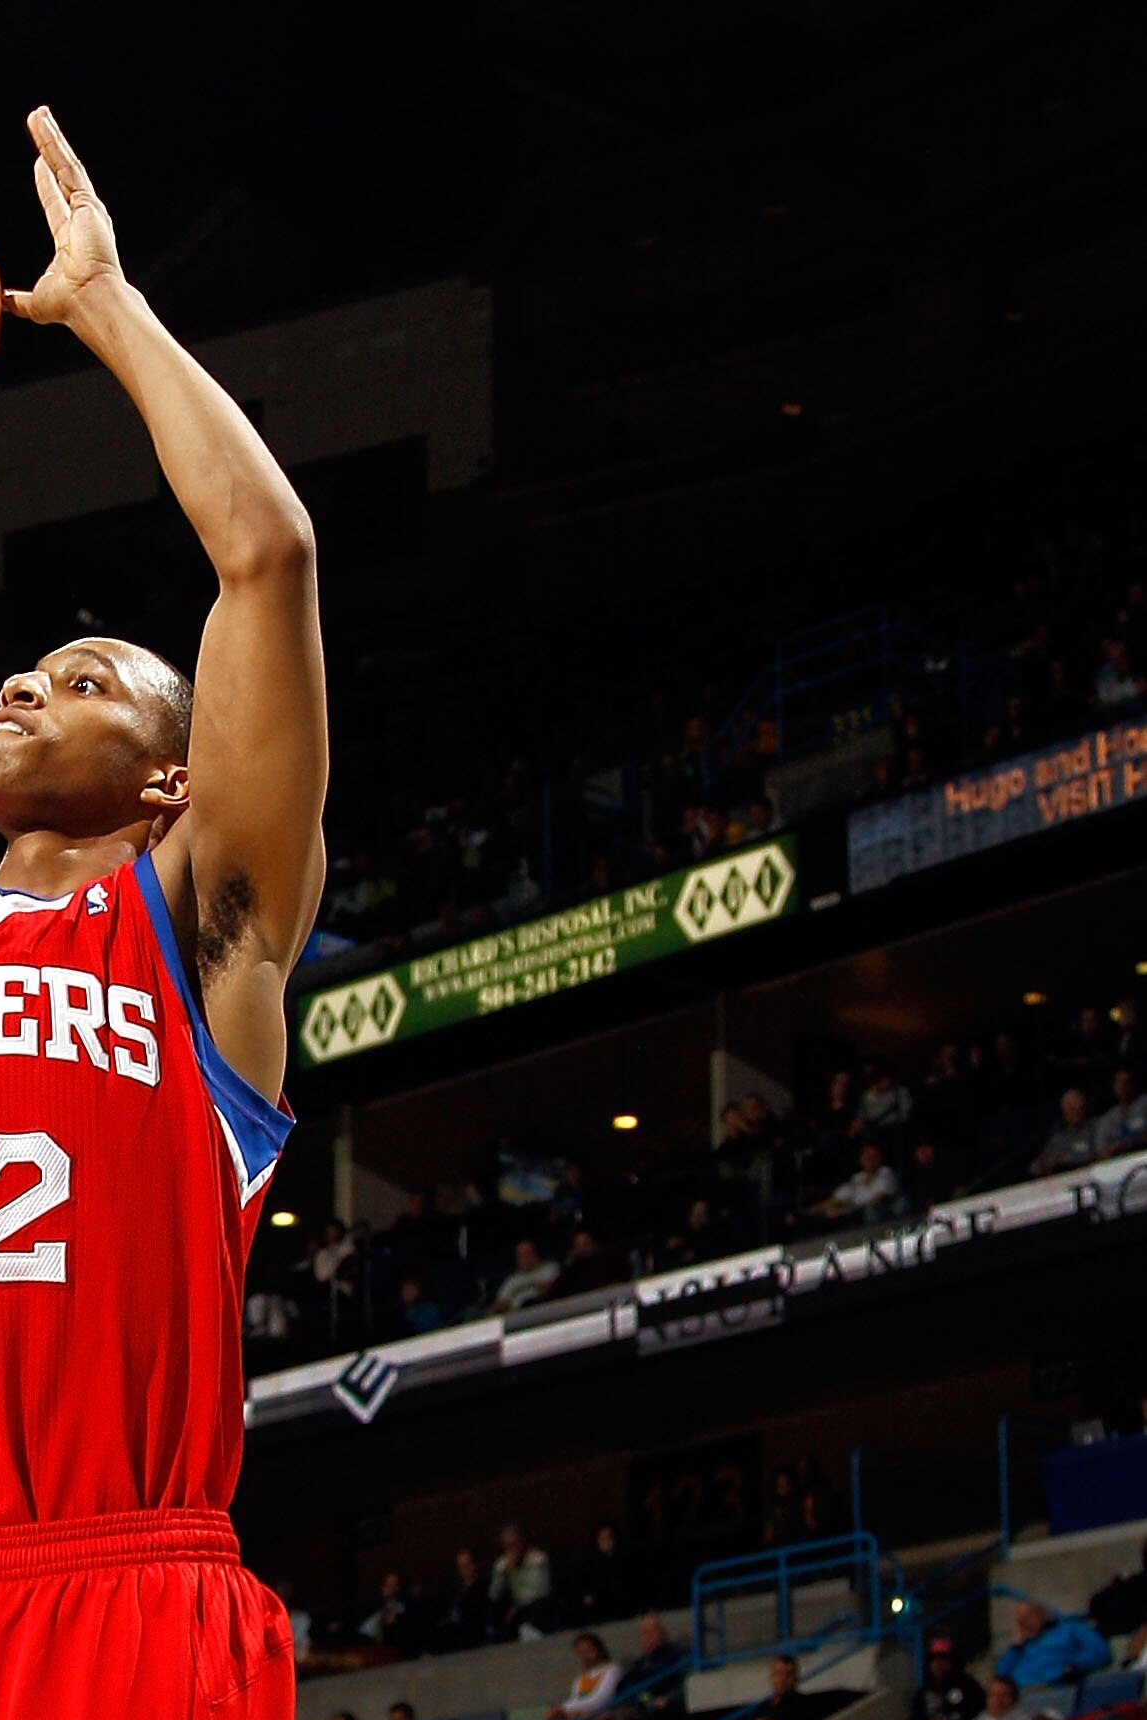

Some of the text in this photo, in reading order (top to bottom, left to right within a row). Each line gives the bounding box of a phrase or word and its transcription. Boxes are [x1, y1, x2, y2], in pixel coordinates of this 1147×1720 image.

[944, 768, 1027, 816] Hugo
[1037, 767, 1117, 824] VISIT
[624, 880, 669, 915] INC.
